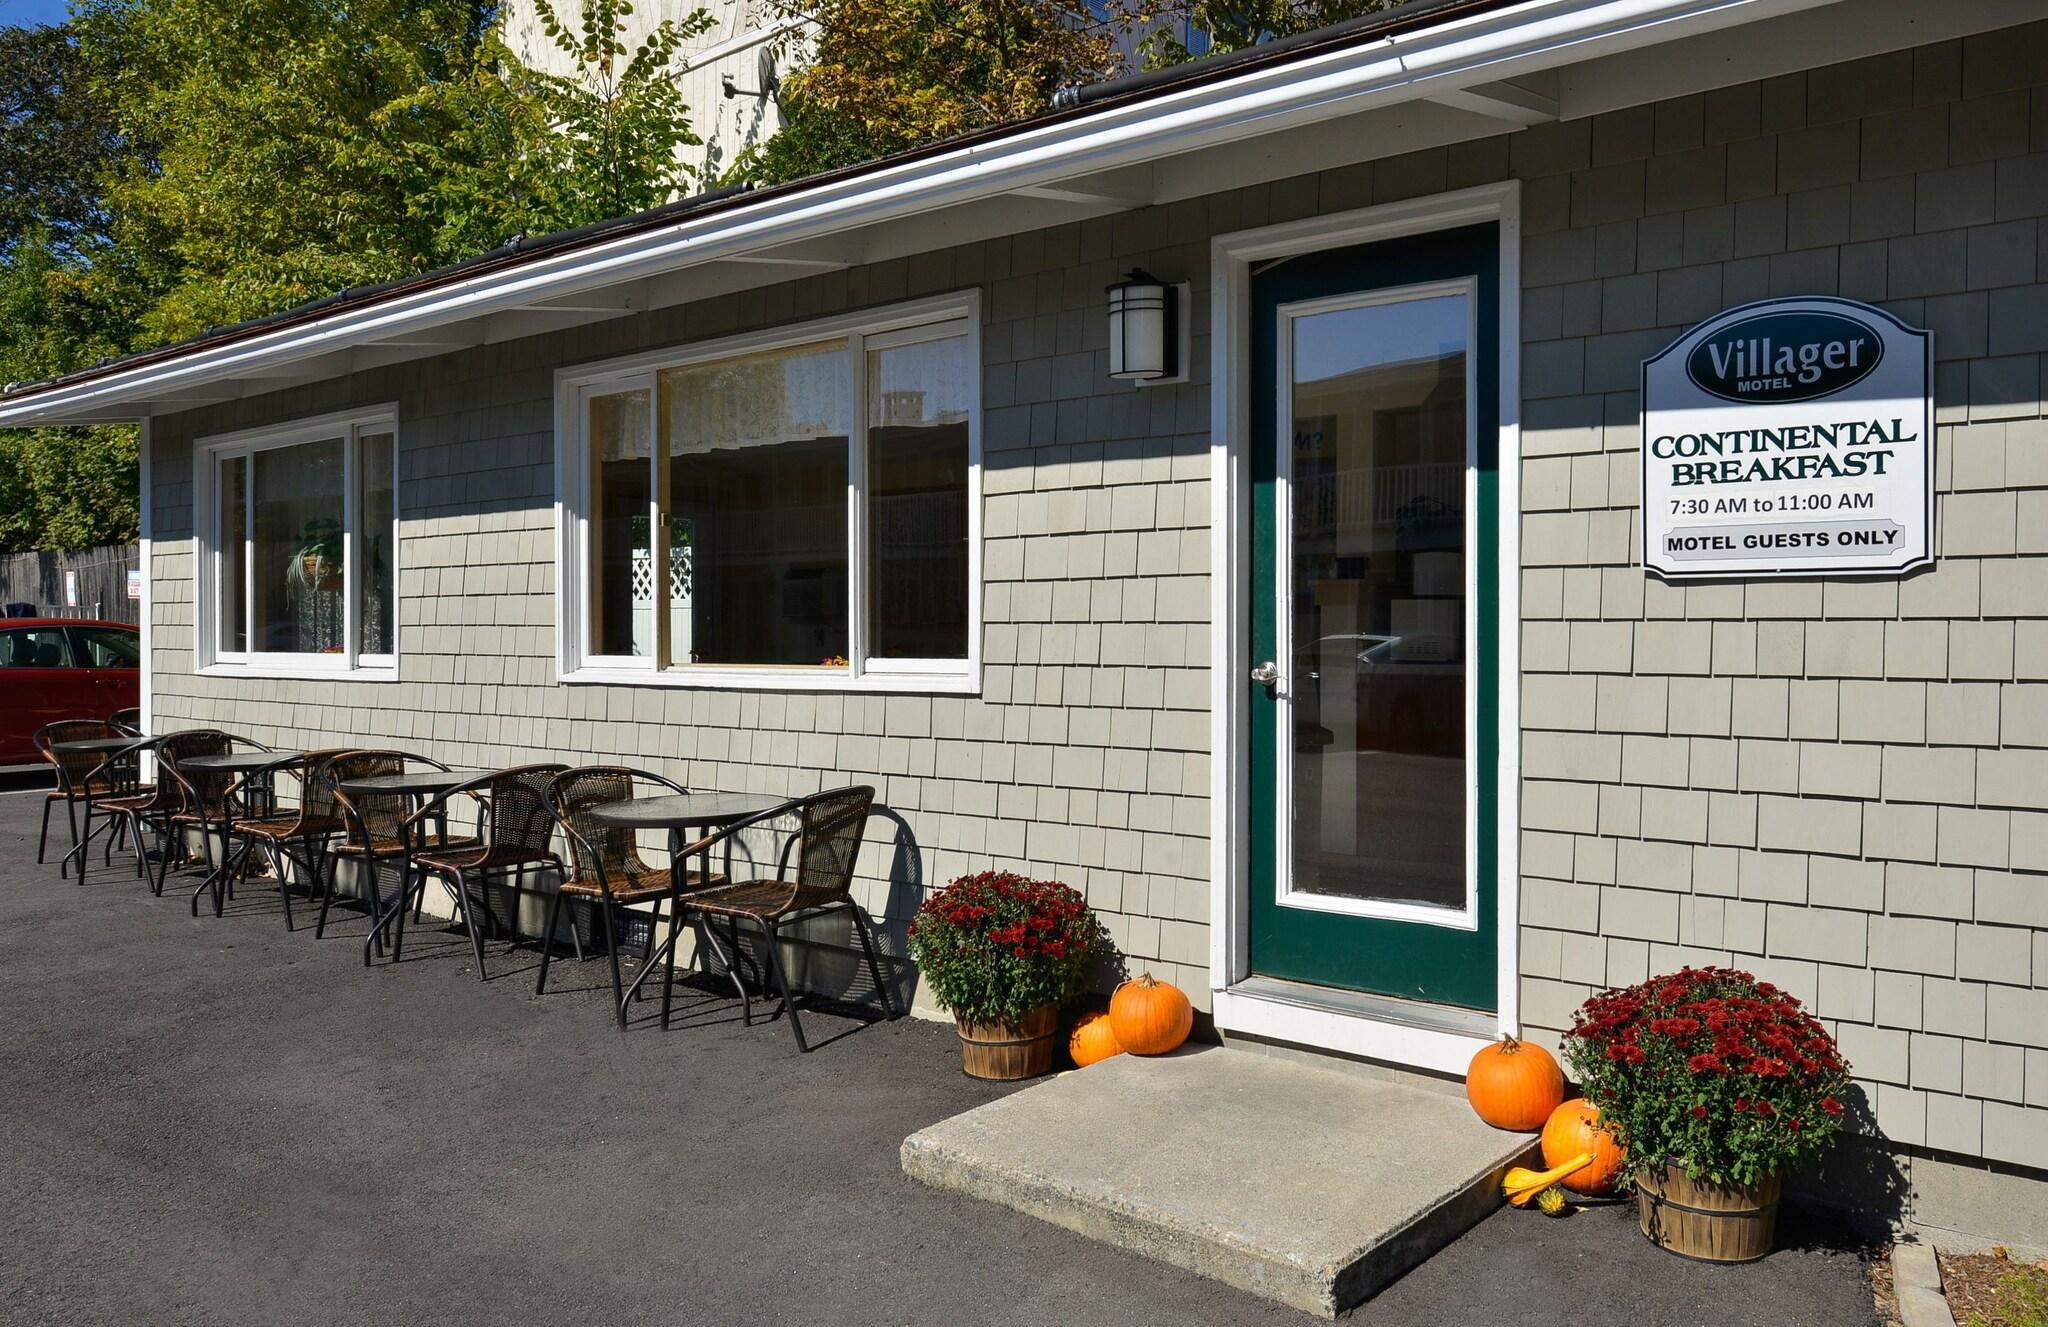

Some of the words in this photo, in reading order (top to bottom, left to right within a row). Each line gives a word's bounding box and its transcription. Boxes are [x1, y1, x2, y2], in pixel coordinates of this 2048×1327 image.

[1708, 337, 1865, 384] Villager
[1737, 377, 1793, 393] MOTEL
[1651, 418, 1918, 460] CONTINENTAL
[1671, 449, 1895, 487] BREAKFAST
[1670, 498, 1709, 515] 7:30
[1714, 497, 1748, 514] AM
[1753, 497, 1774, 513] to
[1777, 493, 1833, 511] 11:00
[1837, 492, 1874, 510] AM
[1667, 535, 1737, 551] MOTEL
[1743, 532, 1830, 550] GUESTS
[1837, 529, 1899, 547] ONLY
